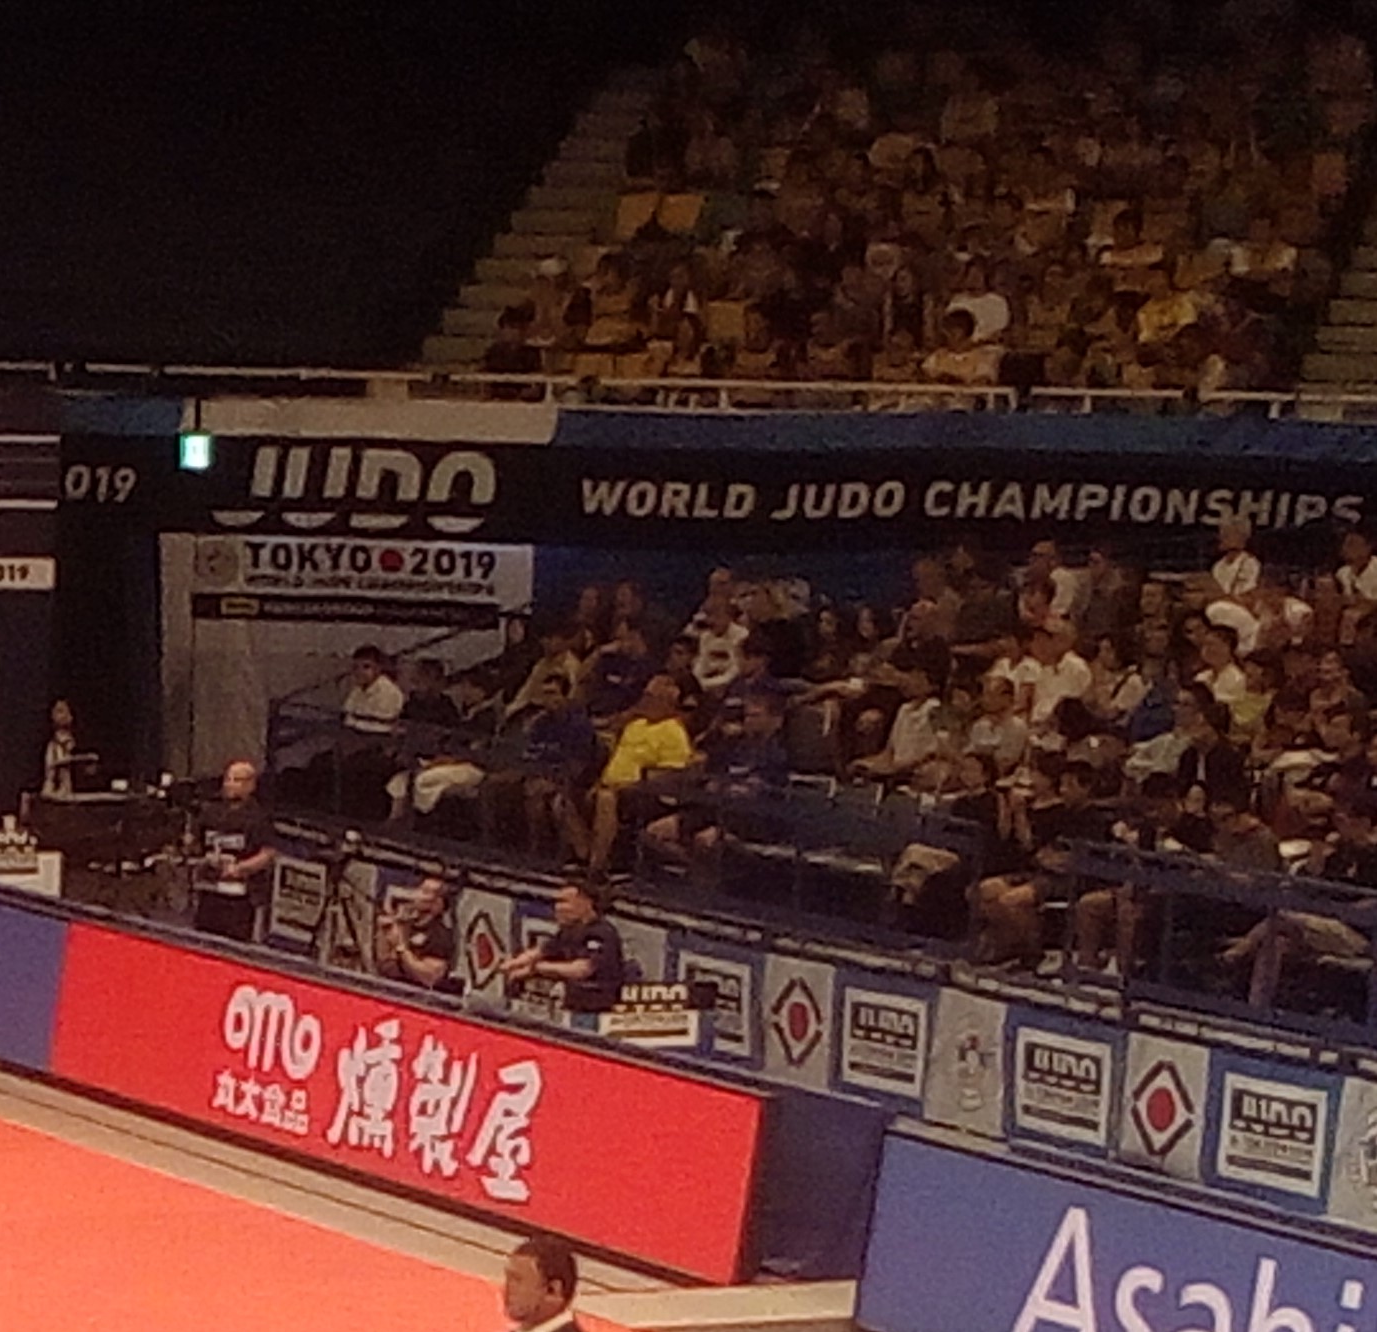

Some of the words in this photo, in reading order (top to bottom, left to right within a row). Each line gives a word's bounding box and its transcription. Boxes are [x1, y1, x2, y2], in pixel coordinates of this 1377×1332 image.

[211, 446, 497, 534] JUDO
[581, 478, 756, 520] WORLD
[771, 481, 906, 520] JUDO
[924, 480, 1366, 530] CHAMPIONSHIPS
[246, 541, 373, 574] TOKYO
[409, 549, 497, 580] 2019
[212, 1068, 309, 1136] 丸大食品
